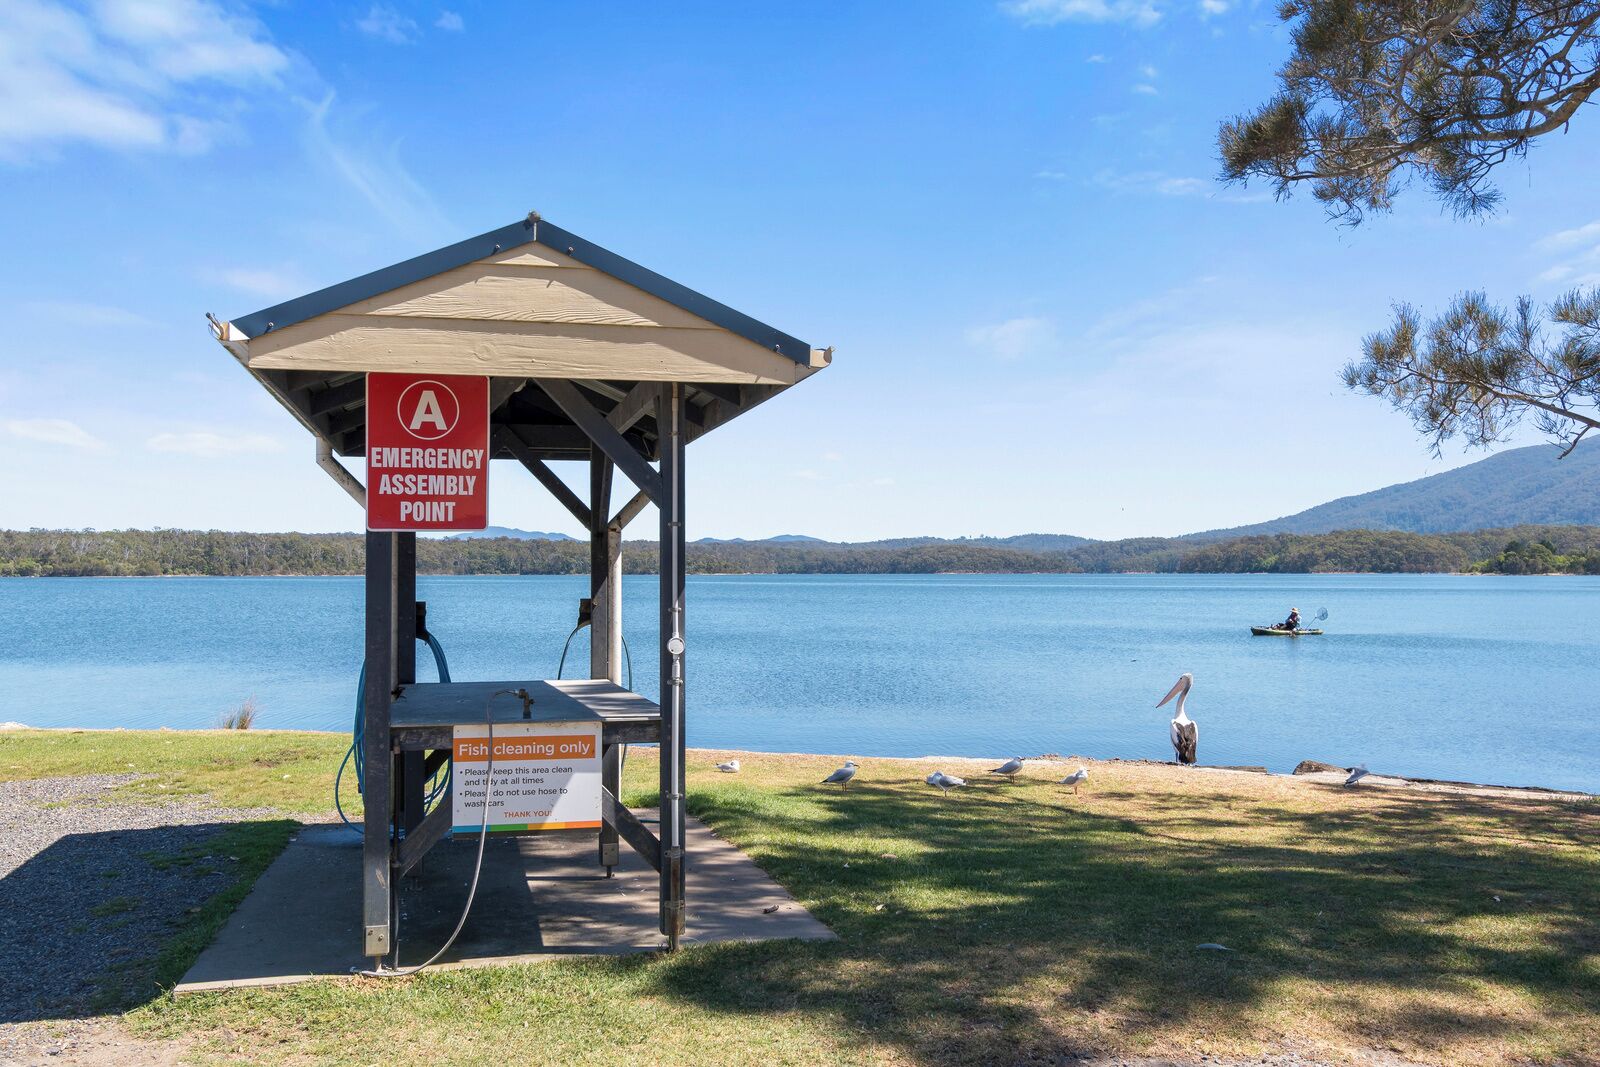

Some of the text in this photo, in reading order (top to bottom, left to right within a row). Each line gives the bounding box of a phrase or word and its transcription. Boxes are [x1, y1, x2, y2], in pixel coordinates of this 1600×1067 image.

[409, 390, 448, 430] A
[371, 447, 484, 469] EMERGENCY
[379, 474, 477, 496] ASSEMBLY
[400, 501, 456, 522] POINT
[459, 740, 591, 756] Fish cleaning only
[493, 767, 513, 776] keep
[515, 766, 530, 774] this
[464, 778, 480, 786] and
[482, 777, 498, 787] tdy
[522, 776, 544, 784] times
[464, 790, 489, 798] Pleas
[492, 789, 504, 797] do
[522, 788, 536, 796] use
[538, 787, 558, 796] hose
[559, 787, 568, 795] to
[464, 800, 486, 808] wash
[503, 810, 531, 818] THANK
